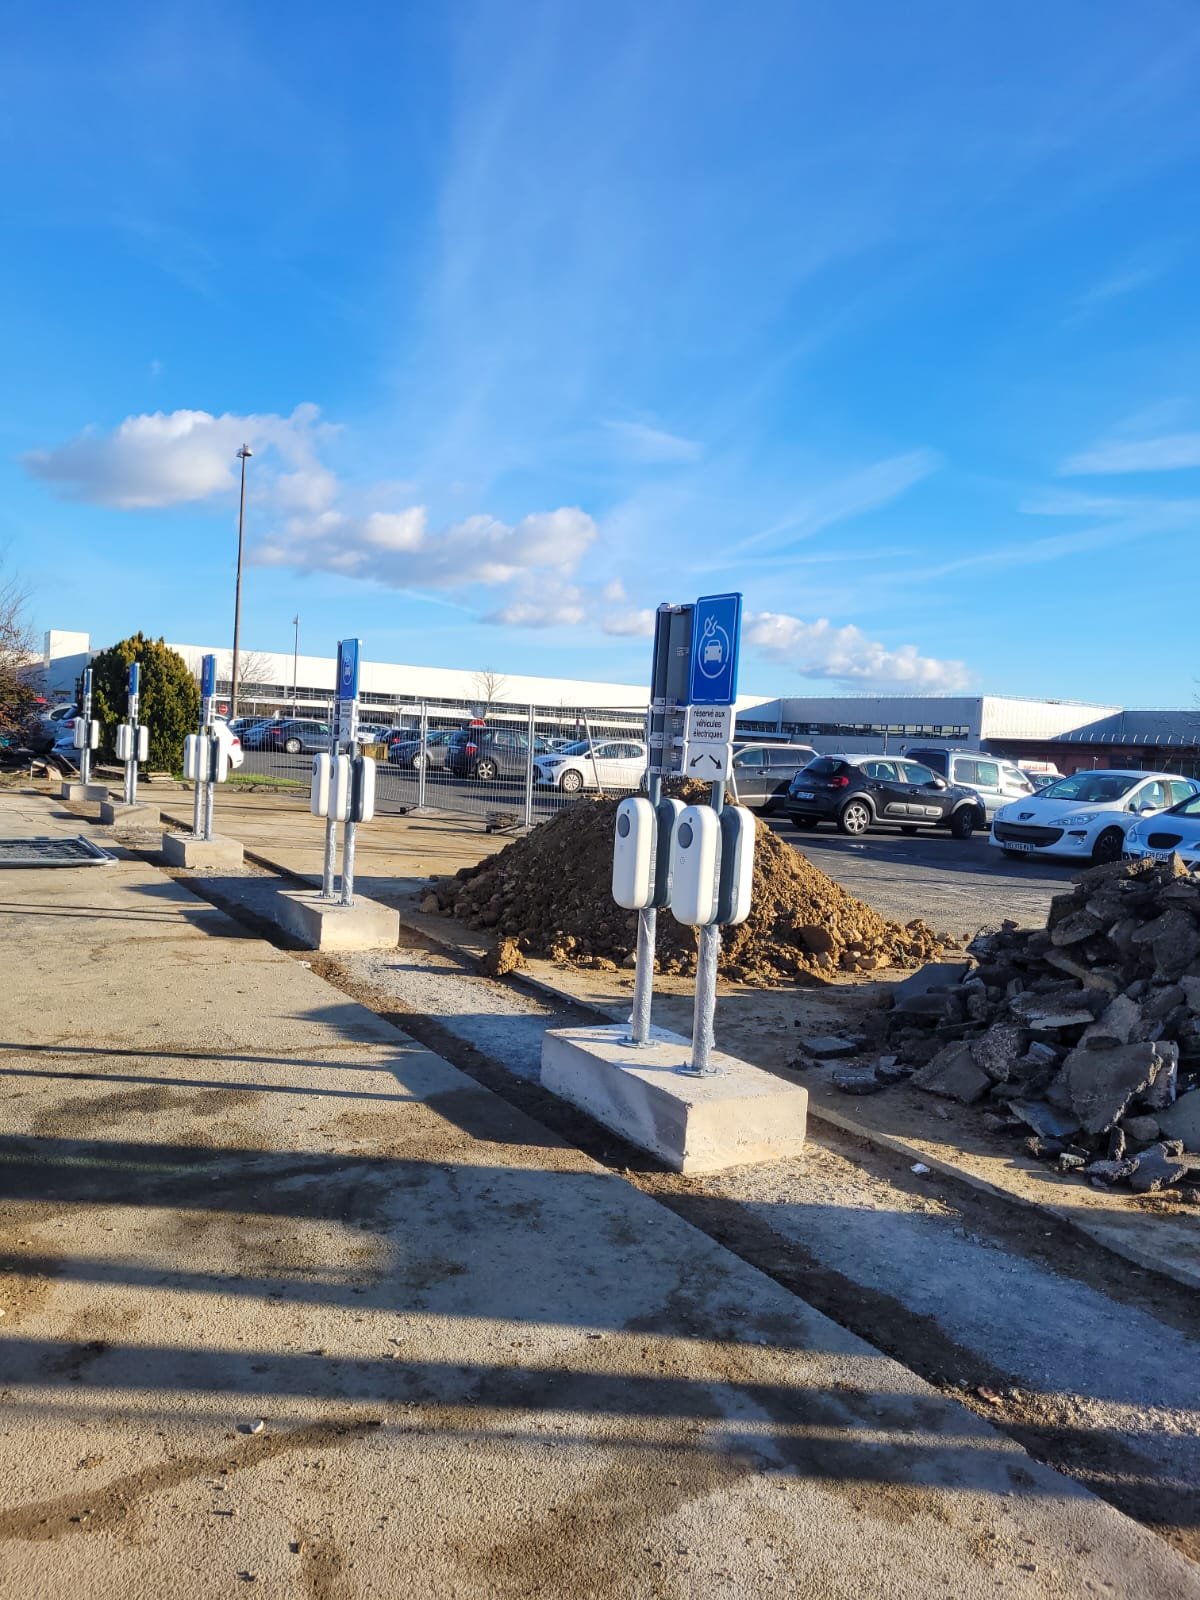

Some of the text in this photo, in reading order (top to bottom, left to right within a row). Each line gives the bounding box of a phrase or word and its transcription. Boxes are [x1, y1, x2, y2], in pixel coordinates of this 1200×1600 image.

[693, 708, 714, 718] réservé
[696, 718, 722, 728] véhicules
[693, 728, 723, 739] électriques
